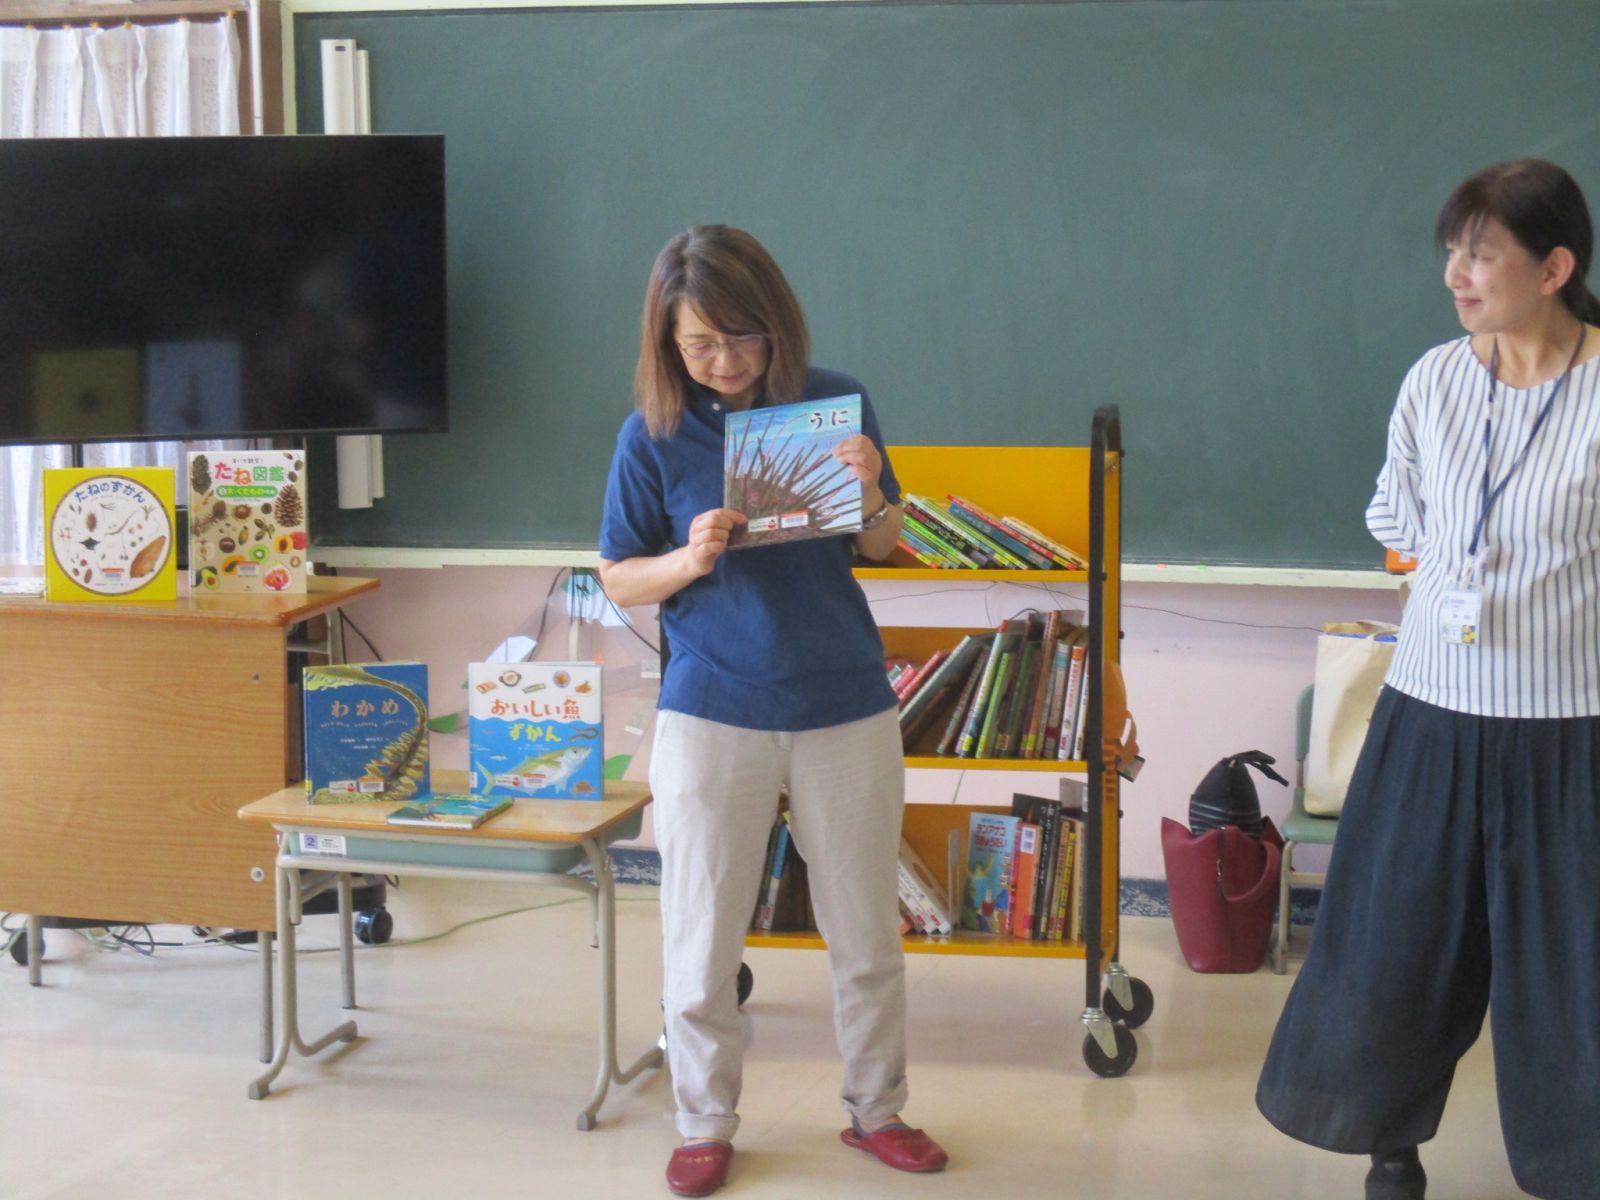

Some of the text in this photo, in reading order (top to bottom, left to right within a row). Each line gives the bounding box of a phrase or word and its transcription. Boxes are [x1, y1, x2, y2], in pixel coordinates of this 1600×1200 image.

[810, 411, 849, 430] うに
[215, 462, 284, 485] たね図鑑
[331, 698, 400, 718] わかめ
[491, 697, 581, 720] おいしい魚
[509, 723, 562, 742] ずかん
[306, 837, 315, 847] 2
